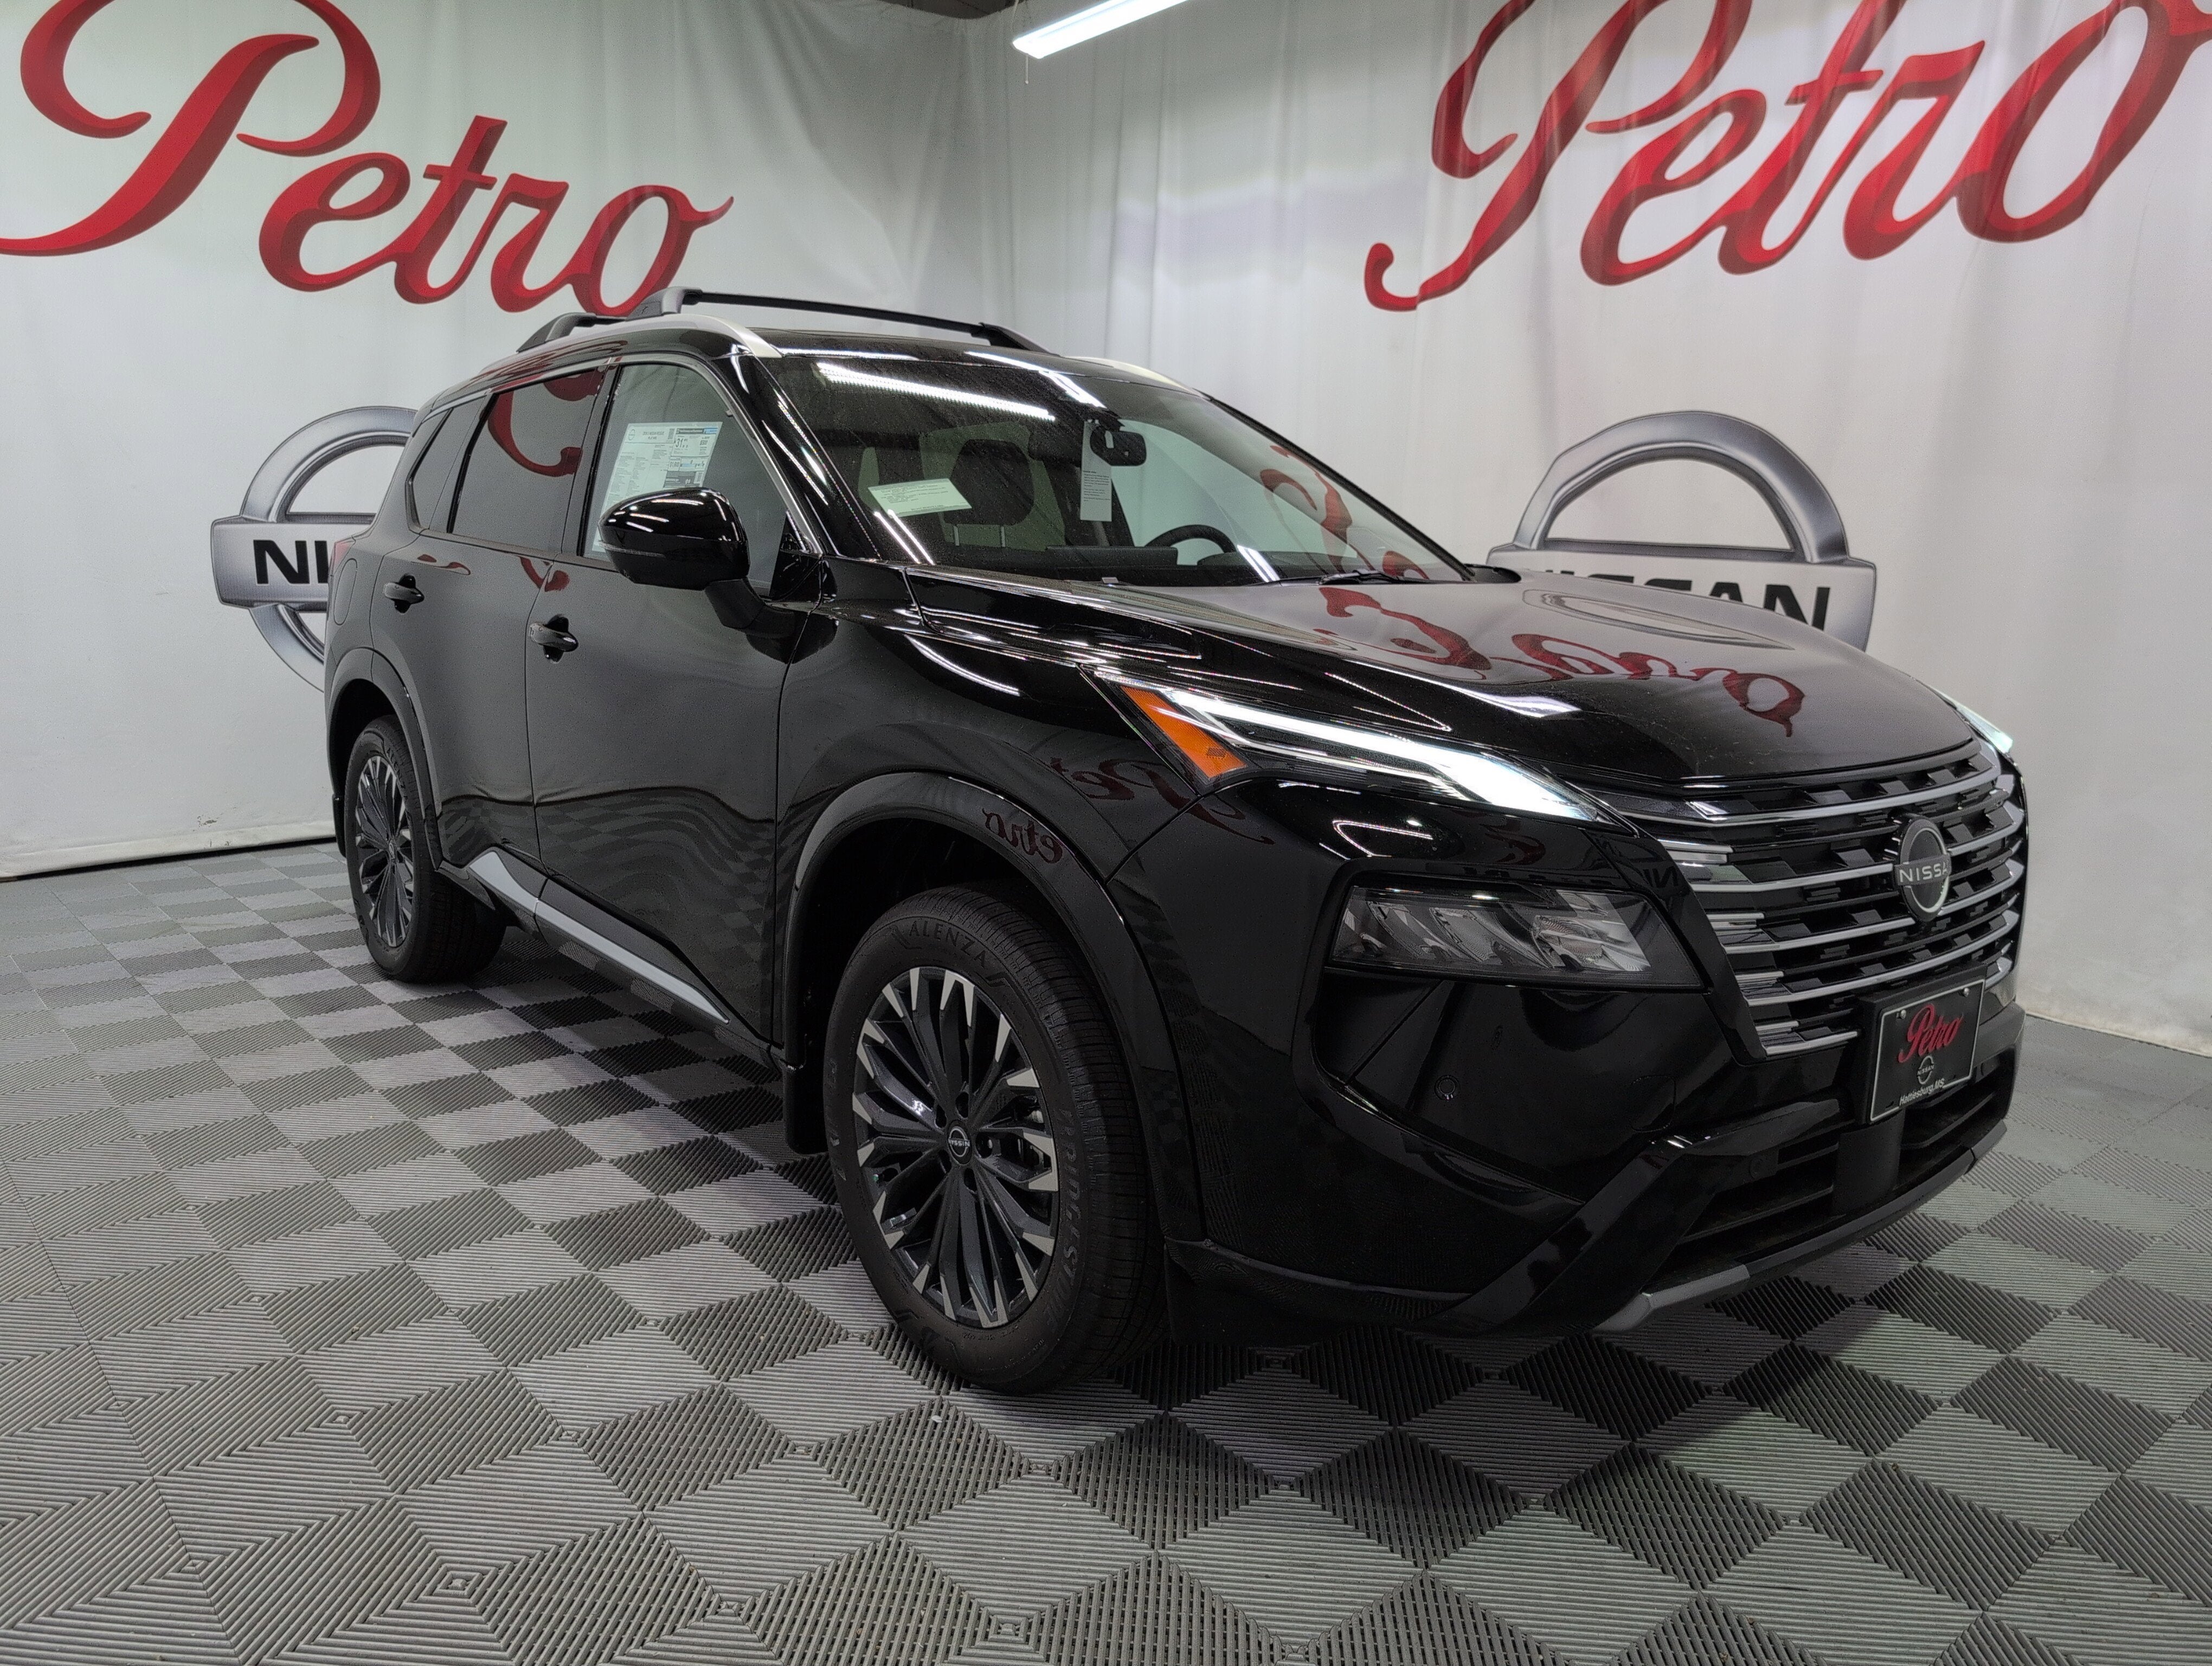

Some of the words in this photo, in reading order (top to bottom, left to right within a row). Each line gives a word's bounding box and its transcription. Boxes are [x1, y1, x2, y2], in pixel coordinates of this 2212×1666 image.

[0, 0, 734, 316] Petro
[1364, 0, 2212, 312] Petro
[1899, 861, 1949, 882] NISSA
[909, 920, 986, 969] ALENZA
[1898, 1004, 1964, 1063] Petro
[1918, 1065, 1934, 1075] NISSAN
